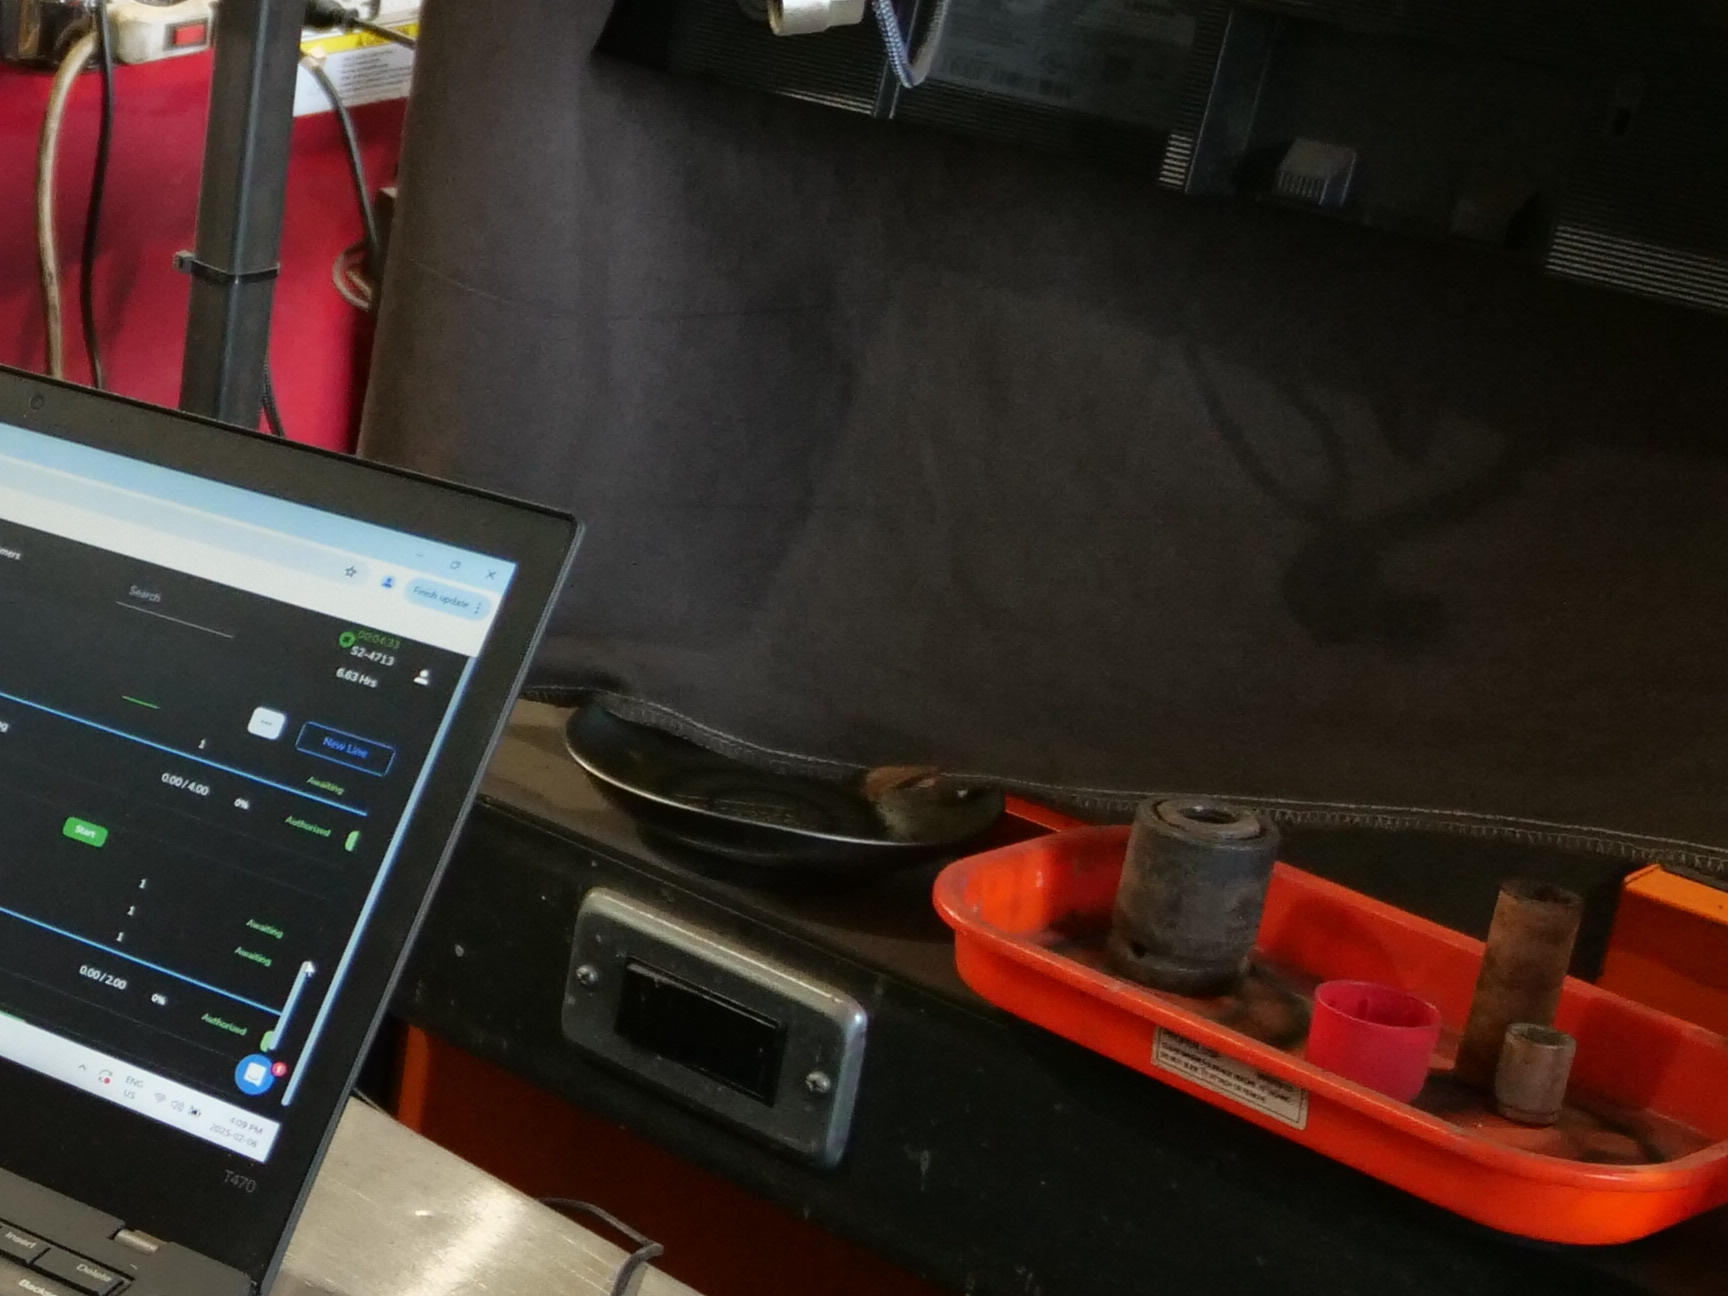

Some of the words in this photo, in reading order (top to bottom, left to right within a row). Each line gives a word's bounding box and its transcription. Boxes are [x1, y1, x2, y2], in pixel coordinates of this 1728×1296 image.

[128, 584, 161, 603] Search
[412, 585, 438, 600] Finish
[438, 595, 470, 608] update
[350, 645, 395, 666] S2-4713
[335, 667, 359, 682] 6.63
[358, 674, 377, 688] Hrs
[322, 736, 347, 751] New
[345, 743, 369, 758] Line
[160, 772, 184, 787] 0.00
[187, 781, 210, 796] 4.00
[306, 775, 345, 796] Awaiting
[74, 824, 96, 838] Start
[284, 815, 332, 837] Authorized
[245, 918, 284, 939] Awaiting
[234, 946, 272, 967] Awaiting
[79, 964, 101, 980] 0.00
[104, 974, 127, 990] 2.00
[201, 1012, 248, 1036] Authorized
[124, 1075, 143, 1088] ENG
[123, 1088, 136, 1100] US
[209, 1123, 258, 1148] 2025-02-06
[229, 1116, 248, 1129] 4:09
[247, 1123, 264, 1134] PM
[223, 1168, 257, 1193] T470
[5, 1230, 37, 1250] Insert
[76, 1262, 112, 1283] Delete
